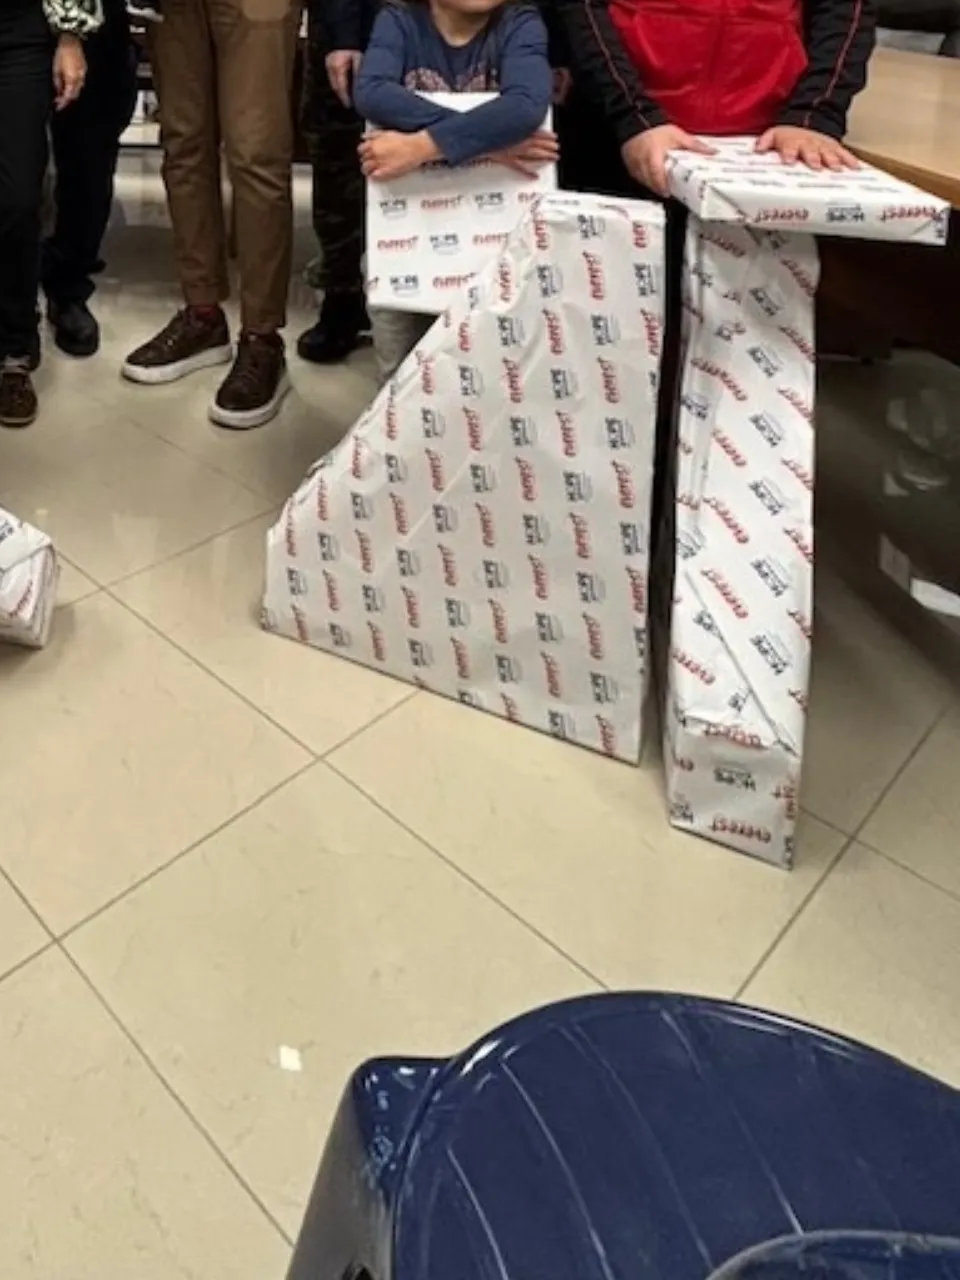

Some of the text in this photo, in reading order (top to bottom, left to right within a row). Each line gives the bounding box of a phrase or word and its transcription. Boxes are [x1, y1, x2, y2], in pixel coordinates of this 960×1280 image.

[377, 235, 418, 250] everest
[582, 250, 605, 301] everest
[702, 495, 749, 544] everest
[700, 569, 749, 618] everest
